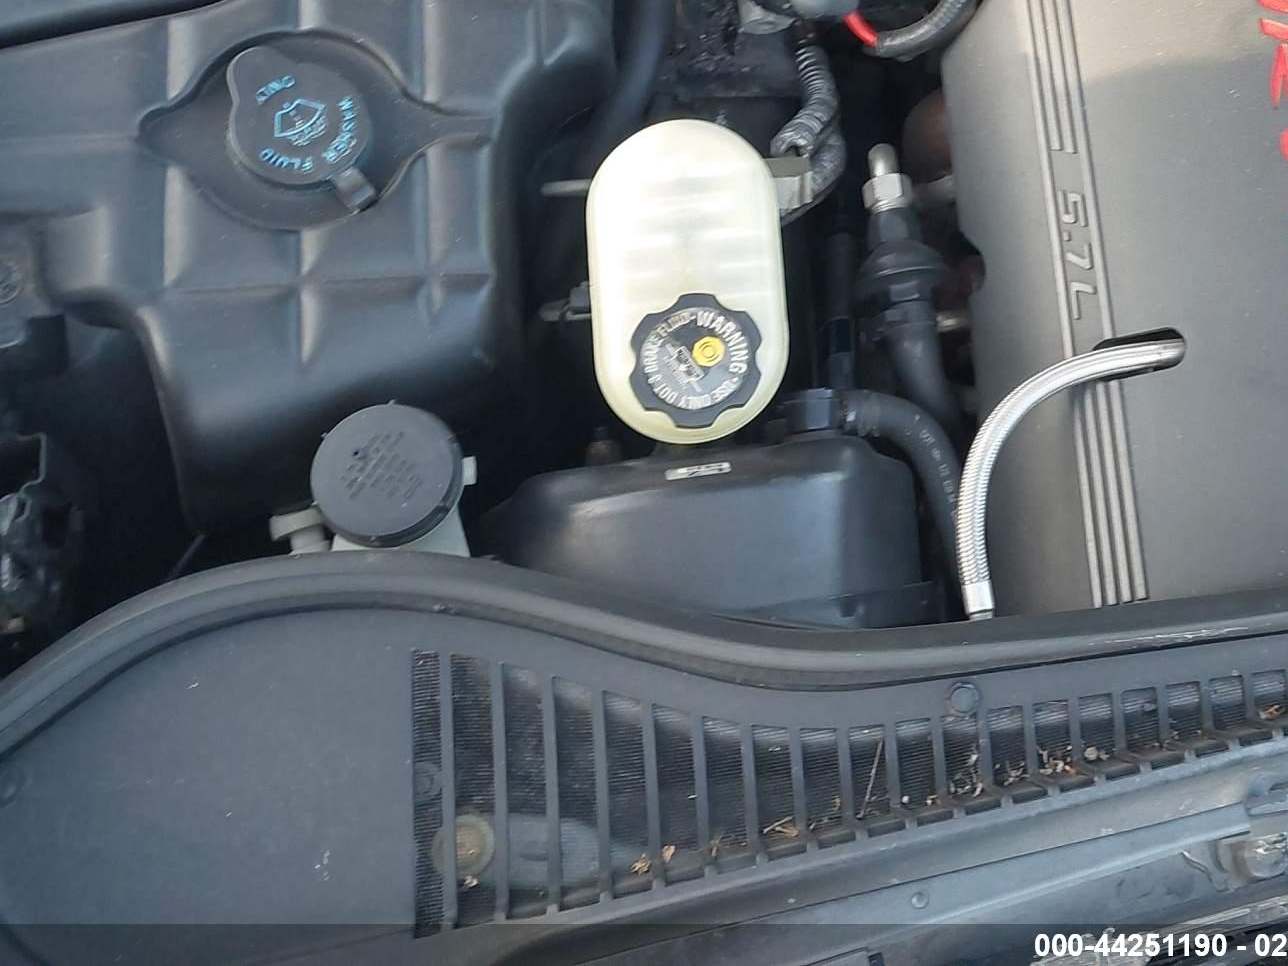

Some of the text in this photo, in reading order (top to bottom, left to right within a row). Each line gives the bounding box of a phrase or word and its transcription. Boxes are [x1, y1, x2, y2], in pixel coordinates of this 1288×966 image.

[260, 97, 357, 173] WASHER FLUID
[1056, 192, 1103, 321] 5.7L
[697, 310, 748, 374] WARNING
[653, 383, 677, 405] DOT
